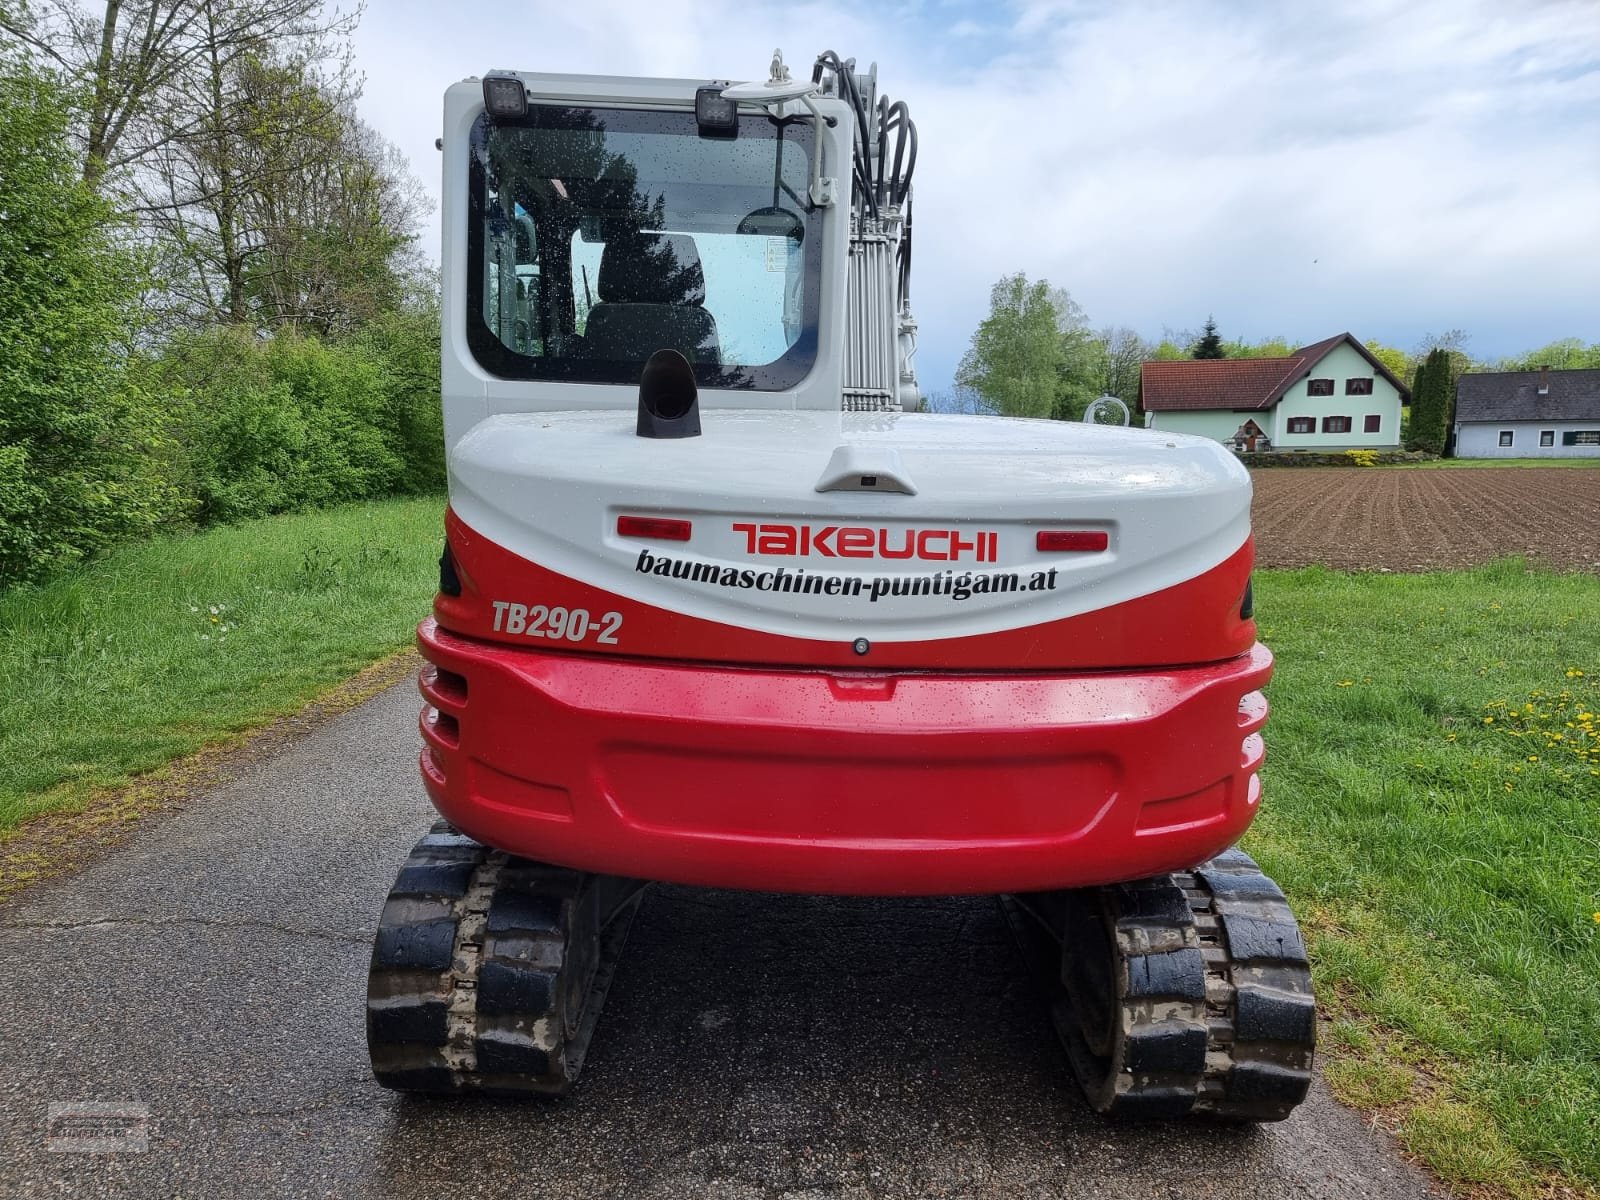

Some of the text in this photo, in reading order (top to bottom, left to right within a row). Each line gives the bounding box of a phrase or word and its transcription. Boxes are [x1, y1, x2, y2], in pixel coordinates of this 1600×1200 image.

[732, 523, 998, 562] TAKEUCHI
[635, 549, 1059, 602] baumaschinen-puntigam.at
[492, 600, 623, 645] TB290-2
